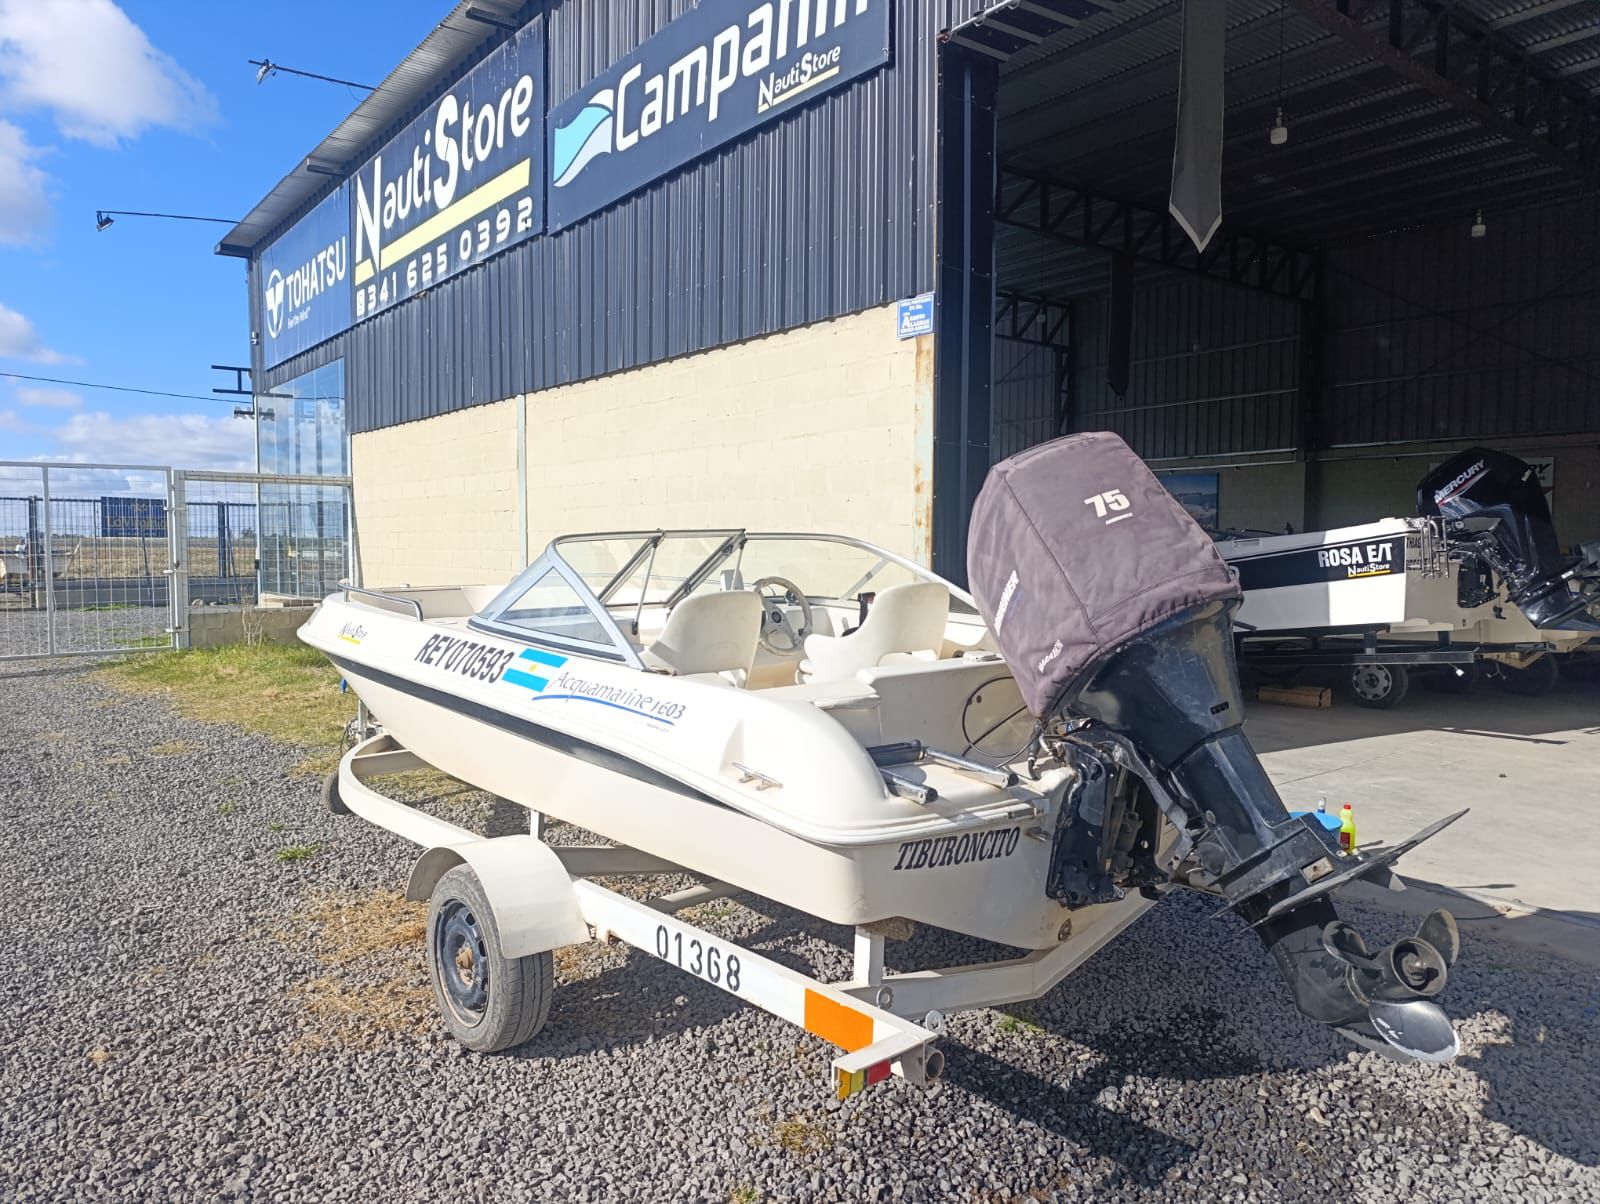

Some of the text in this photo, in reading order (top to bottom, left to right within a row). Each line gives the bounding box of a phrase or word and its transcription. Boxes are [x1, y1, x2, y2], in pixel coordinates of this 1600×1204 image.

[757, 46, 841, 107] NautiStore
[355, 74, 533, 273] NautiStore
[407, 244, 448, 290] 625
[459, 196, 533, 262] 0392
[285, 236, 347, 313] TOHATSU
[1084, 489, 1131, 518] 75
[1433, 459, 1485, 504] MERCURY
[1317, 545, 1364, 568] ROSA
[414, 633, 515, 684] REY070593
[552, 670, 686, 720] Acquamarine 1603
[893, 825, 1021, 872] TIBURONCITO
[655, 924, 742, 992] 01368
